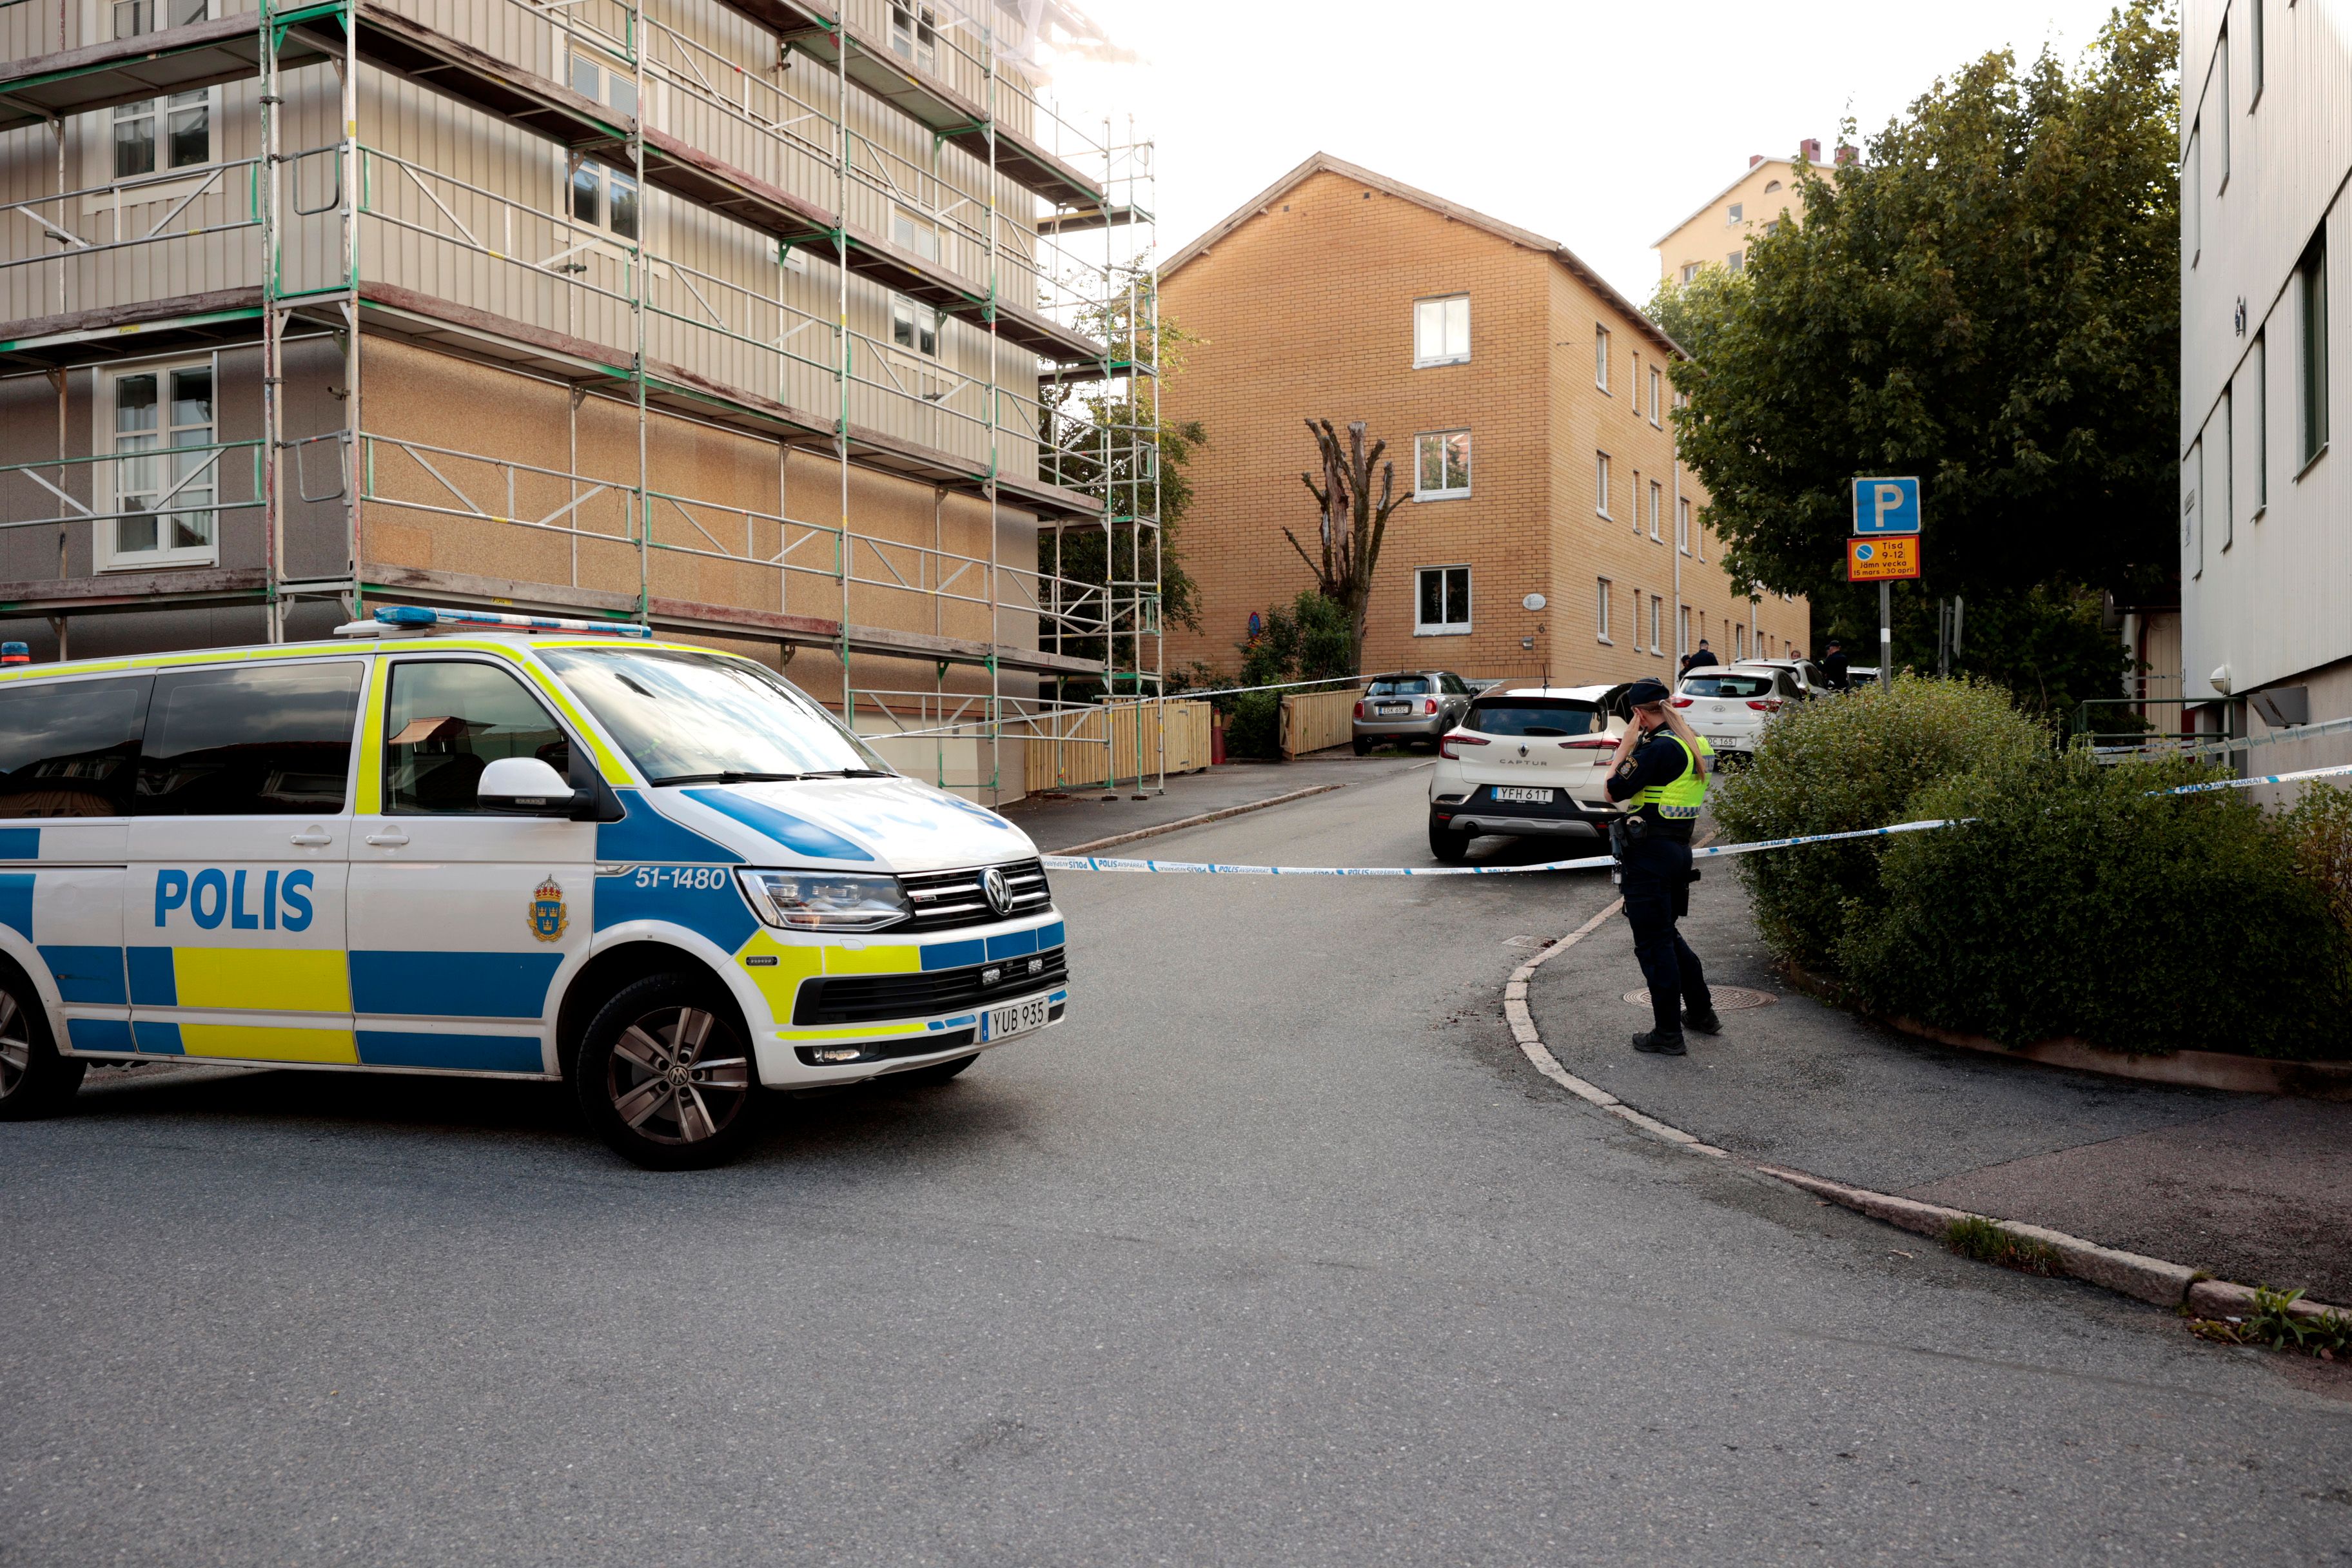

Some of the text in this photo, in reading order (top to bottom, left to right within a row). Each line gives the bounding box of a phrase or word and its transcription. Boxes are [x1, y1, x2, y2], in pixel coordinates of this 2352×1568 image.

[1874, 484, 1904, 527] P
[1538, 623, 1545, 634] 6
[1626, 756, 1637, 767] POLIS
[2180, 783, 2213, 792] POLS
[1502, 788, 1549, 800] YFH 61T
[1099, 859, 1117, 868] POLIS
[635, 867, 726, 890] 51-1480
[155, 868, 314, 932] POLIS
[994, 1009, 1017, 1035] YUB
[1023, 1001, 1043, 1028] 935
